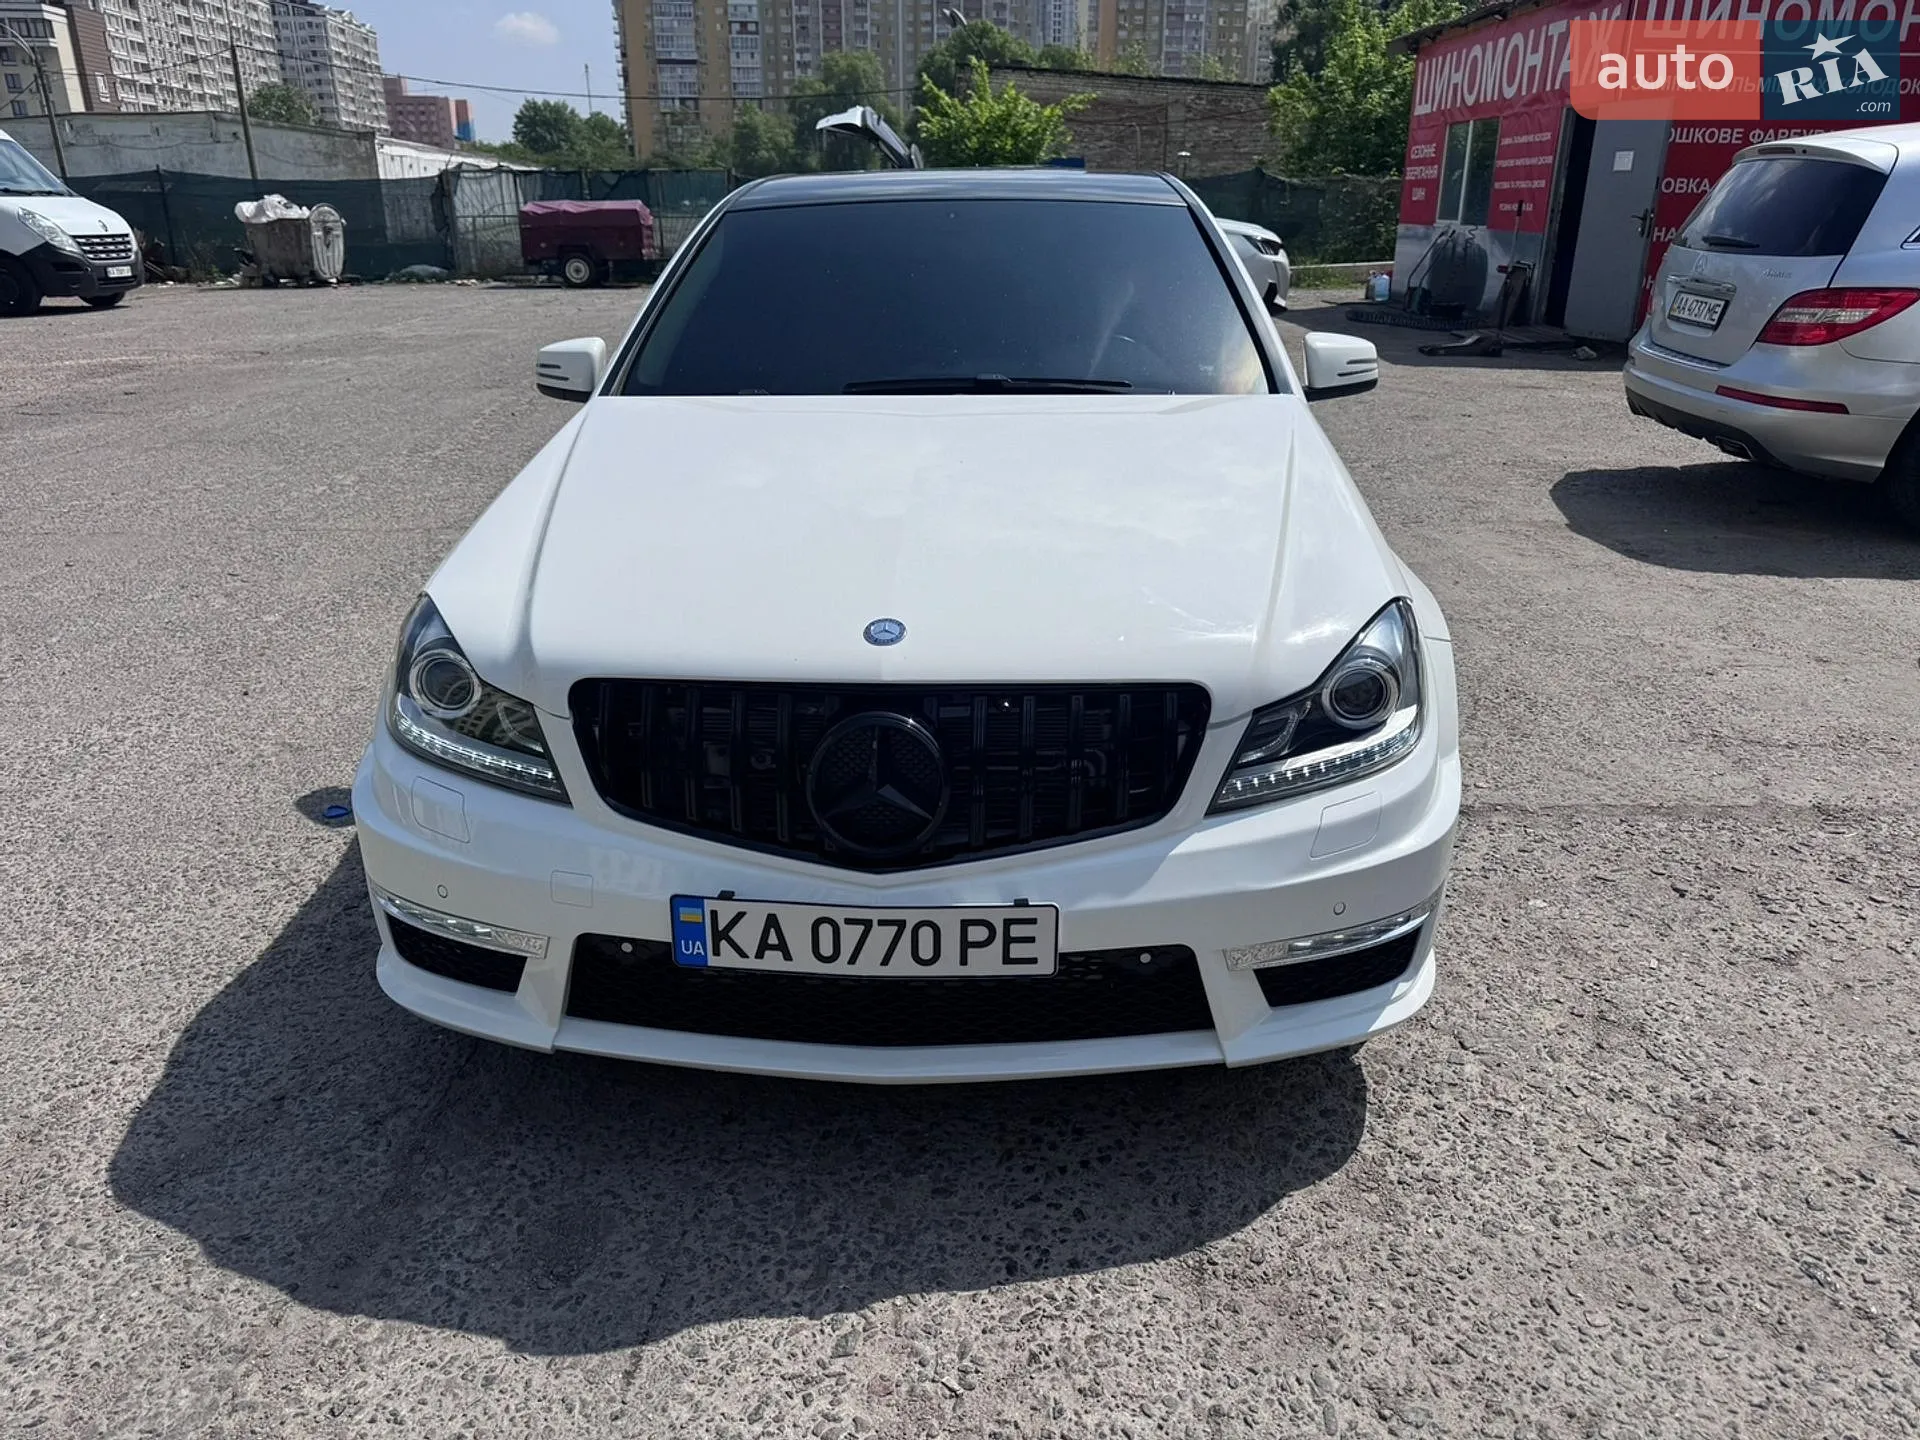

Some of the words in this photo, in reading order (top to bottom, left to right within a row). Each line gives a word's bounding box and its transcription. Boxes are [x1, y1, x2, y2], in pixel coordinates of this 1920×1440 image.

[1413, 4, 1622, 116] ШИНОМОНТАЖ
[681, 940, 705, 956] UA
[710, 909, 793, 962] KA
[811, 916, 942, 967] 0770
[959, 917, 1038, 967] PE
